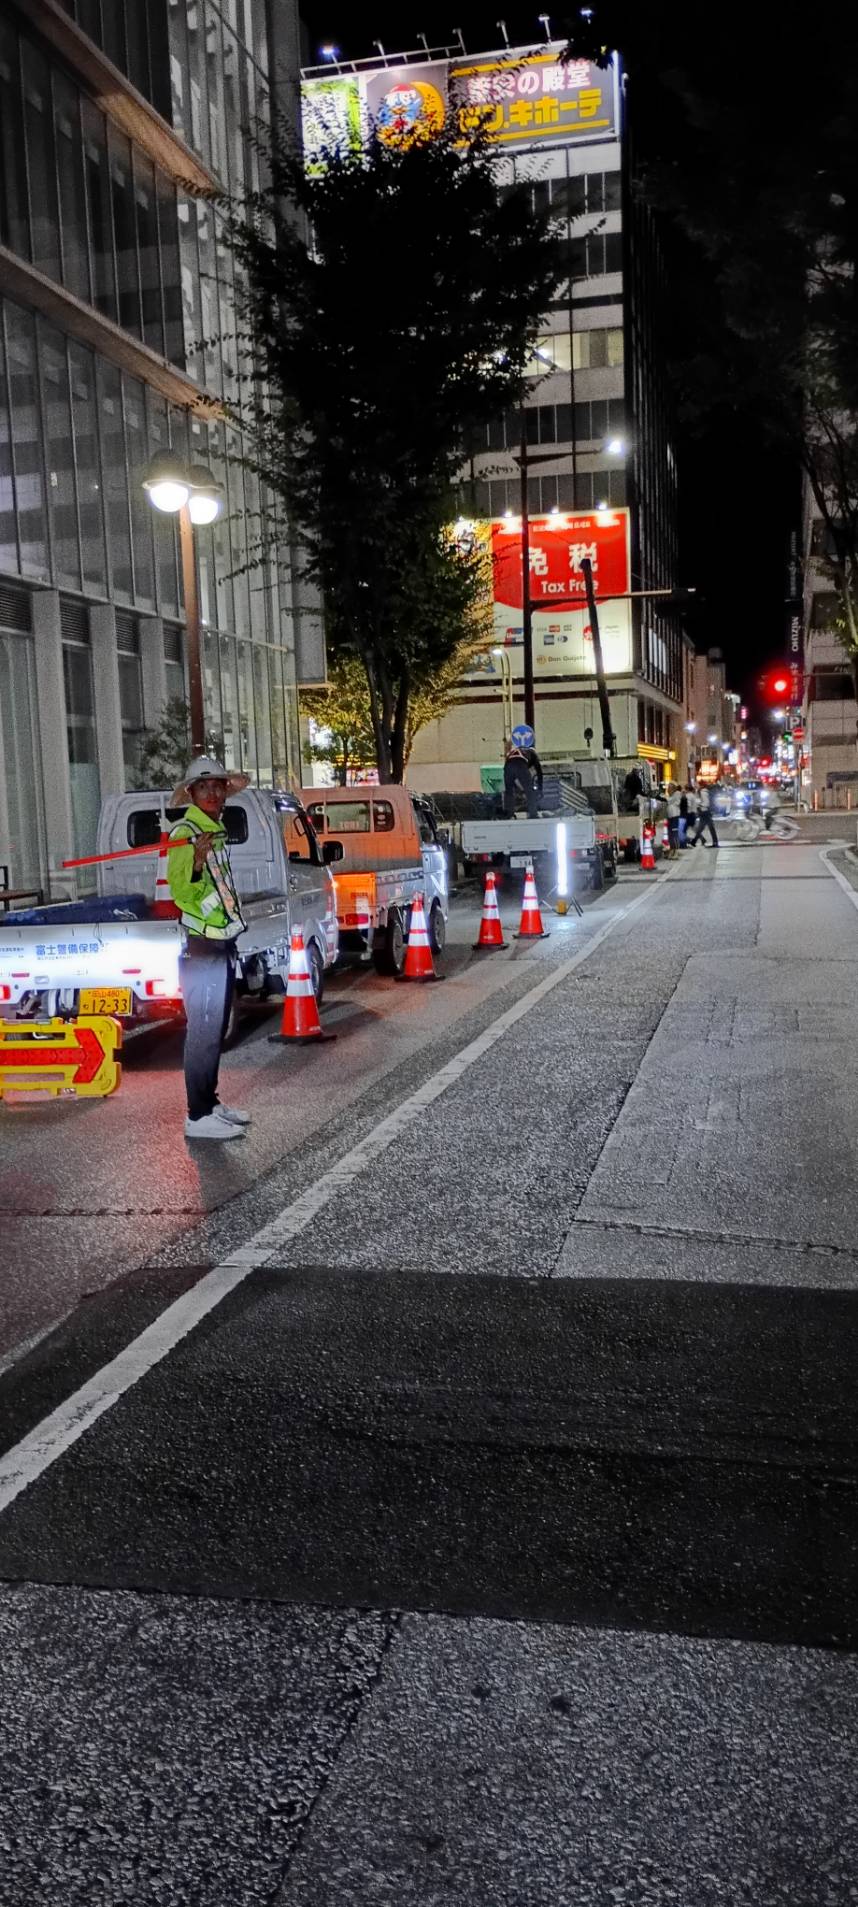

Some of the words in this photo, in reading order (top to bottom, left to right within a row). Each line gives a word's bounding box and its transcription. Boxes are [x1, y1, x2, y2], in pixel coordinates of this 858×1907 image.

[541, 581, 565, 593] Tax
[789, 716, 801, 729] P
[36, 943, 99, 956] 富士警備保障
[92, 998, 128, 1013] 12-33
